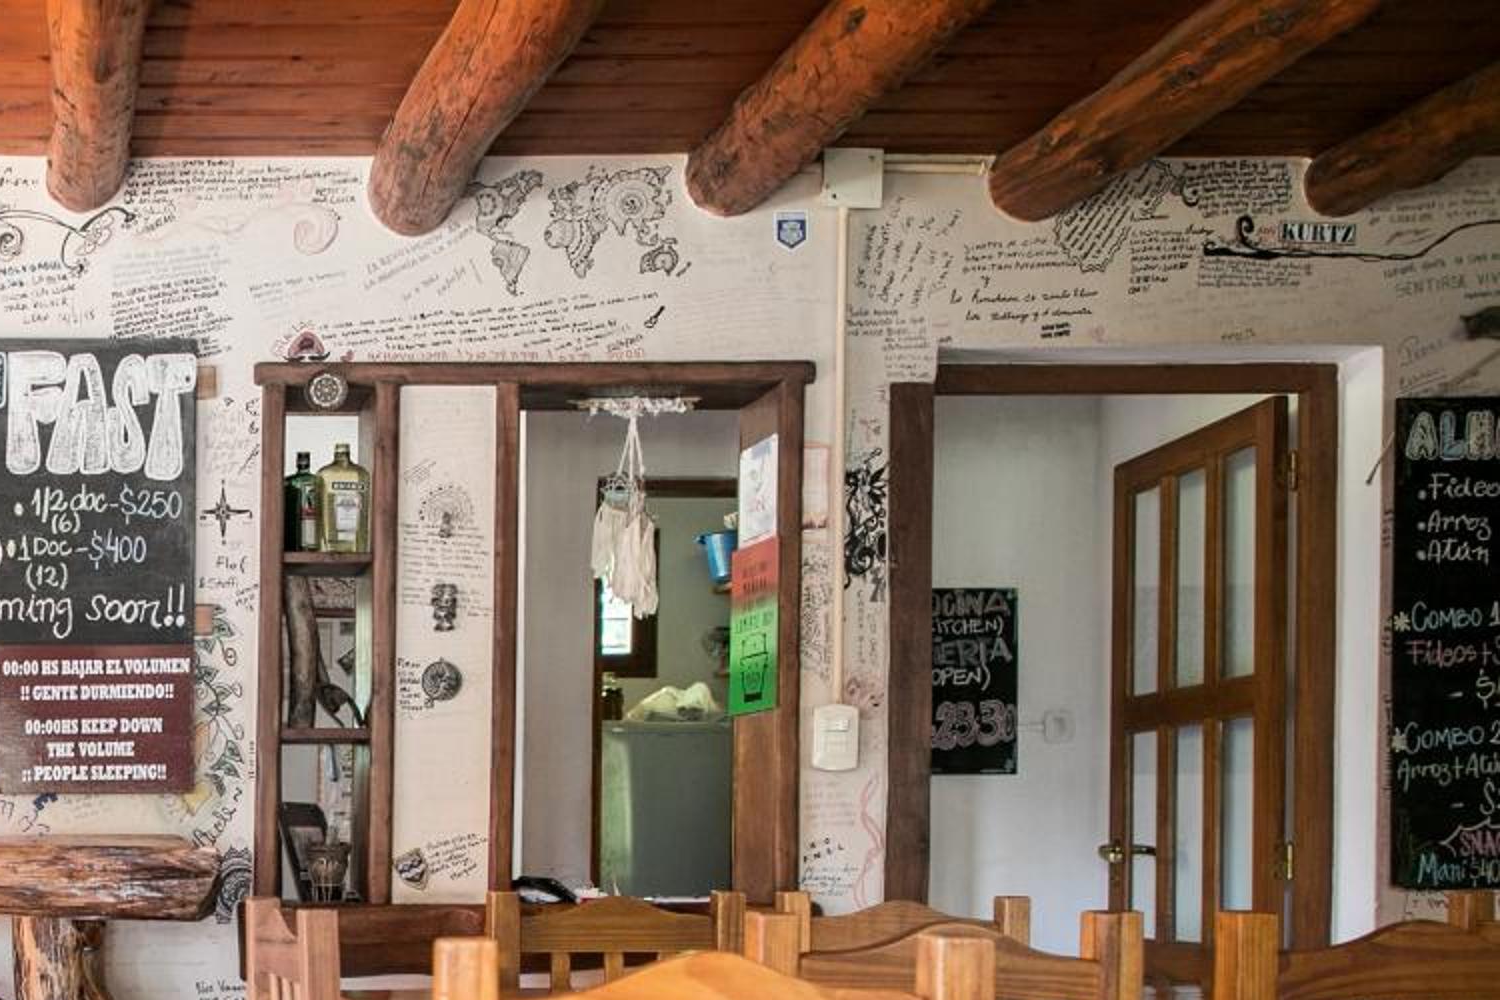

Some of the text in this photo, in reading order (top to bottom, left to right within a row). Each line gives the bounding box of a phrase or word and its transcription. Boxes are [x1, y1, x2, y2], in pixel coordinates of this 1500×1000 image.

[1283, 222, 1357, 243] KURTZ
[5, 350, 198, 481] FAST
[119, 482, 184, 527] $250
[51, 510, 81, 536] (6)
[1427, 509, 1492, 541] Arroz
[87, 527, 148, 571] $400
[25, 560, 70, 592] (12)
[83, 583, 188, 629] soon!!
[932, 616, 1004, 636] ITCHEN)
[3, 657, 192, 679] 00:00 HS BAJAR EL VOLUMEN
[32, 685, 79, 701] GENTE
[81, 718, 119, 735] KEEP
[120, 717, 164, 734] DOWN
[46, 741, 136, 758] THE VOLUME
[33, 765, 89, 781] PEOPLE
